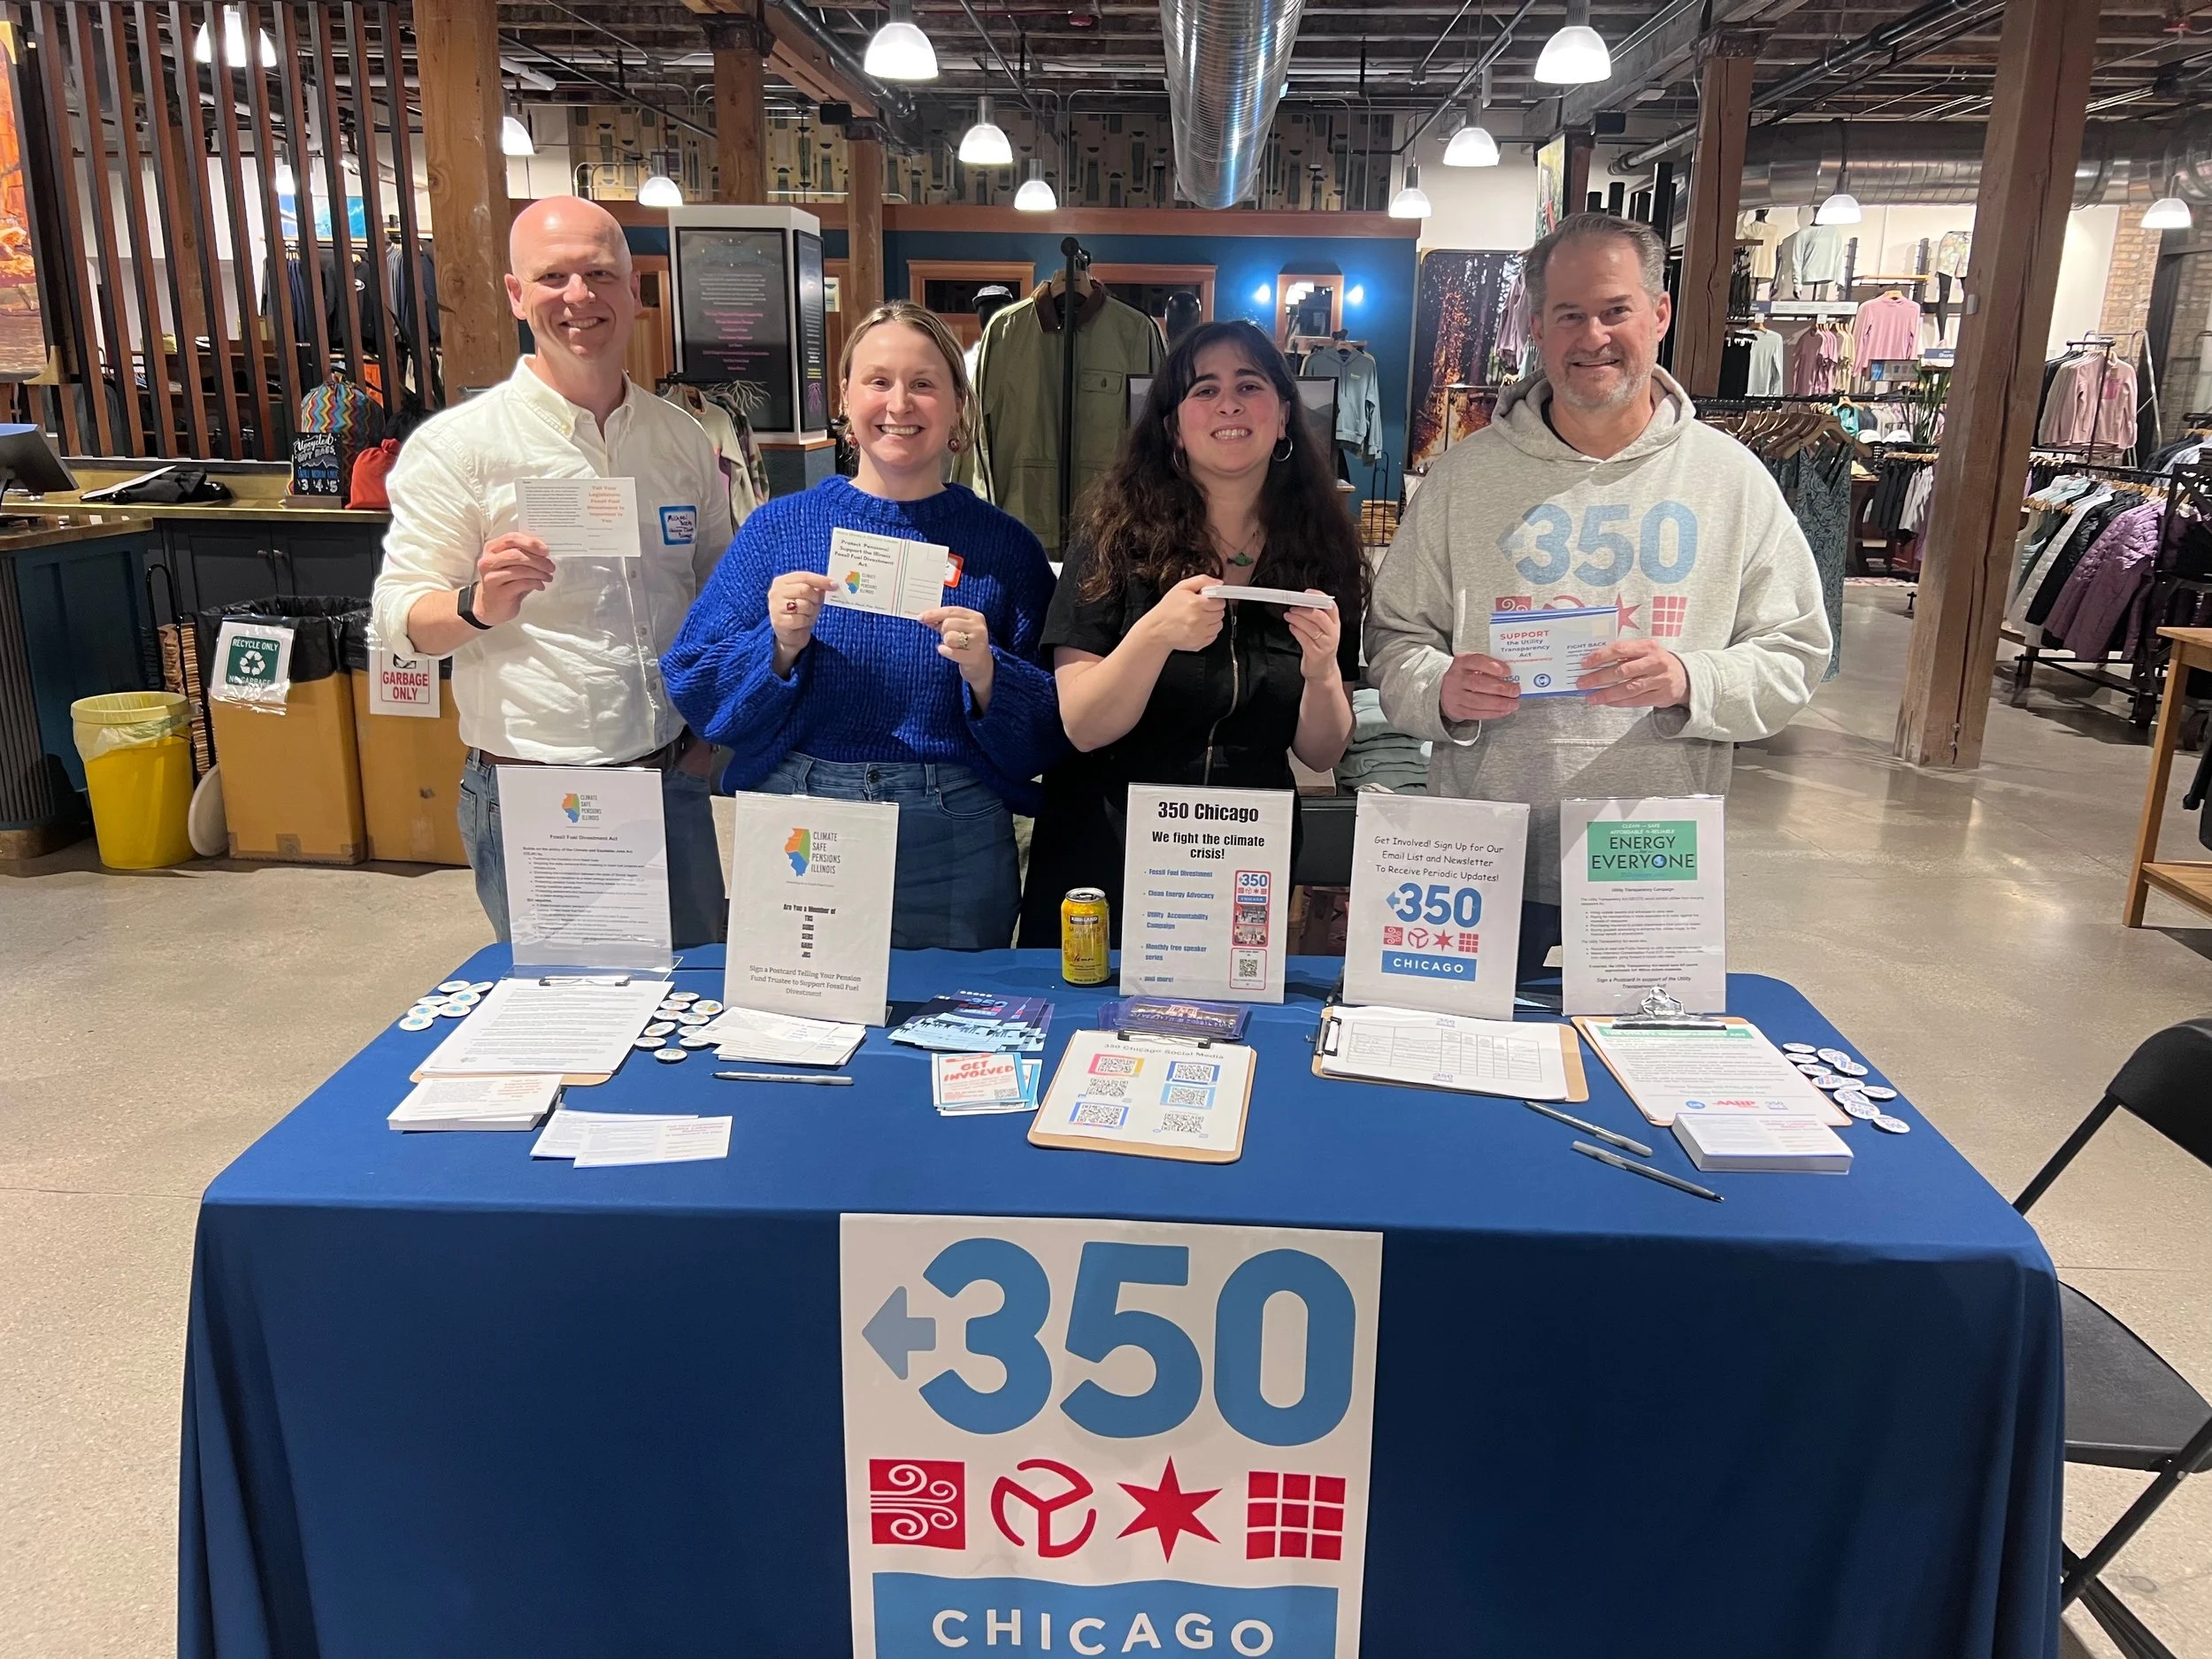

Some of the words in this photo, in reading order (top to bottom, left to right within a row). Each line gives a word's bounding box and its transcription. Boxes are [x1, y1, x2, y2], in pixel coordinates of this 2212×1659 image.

[1516, 500, 1698, 587] 350
[1501, 630, 1550, 641] SUPPORT
[232, 639, 260, 649] RECYCLE
[262, 642, 278, 651] ONLY
[382, 671, 428, 687] GARBAGE
[393, 687, 418, 701] ONLY
[1157, 802, 1189, 819] 350
[1194, 803, 1259, 823] Chicago
[813, 832, 837, 841] CLIMATE
[1152, 832, 1170, 842] We
[1173, 832, 1199, 844] fight
[1202, 833, 1219, 844] the
[1224, 834, 1265, 847] climate
[1610, 836, 1676, 849] ENERGY
[812, 842, 826, 851] SAFE
[1375, 835, 1390, 844] Get
[1393, 837, 1432, 848] Involved!
[1433, 841, 1452, 851] Sign
[1455, 842, 1467, 852] Up
[1486, 844, 1504, 853] Our
[812, 854, 841, 864] PENSIONS
[1190, 848, 1225, 859] crisis!
[1382, 851, 1405, 860] Email
[1407, 853, 1423, 862] List
[1426, 855, 1441, 864] and
[1444, 856, 1494, 867] Newsletter
[1592, 854, 1695, 869] EVERYONE
[810, 864, 835, 874] ILLINOIS
[1388, 865, 1421, 876] Receive
[1423, 869, 1458, 879] Periodic
[1460, 872, 1499, 882] Updates!
[1241, 874, 1268, 887] 350
[1166, 890, 1185, 899] Energy
[1395, 882, 1482, 927] 350
[1168, 911, 1209, 920] Accountability
[1393, 957, 1464, 973] CHICAGO
[750, 964, 763, 973] Sign
[798, 970, 818, 979] Telling
[836, 973, 862, 982] Pension
[786, 987, 821, 996] Divestment
[972, 997, 1009, 1007] 350
[943, 1065, 1014, 1081] INVOLVED
[961, 1061, 988, 1071] GET
[918, 1237, 1356, 1447] 350
[933, 1609, 1274, 1656] CHICAGO
